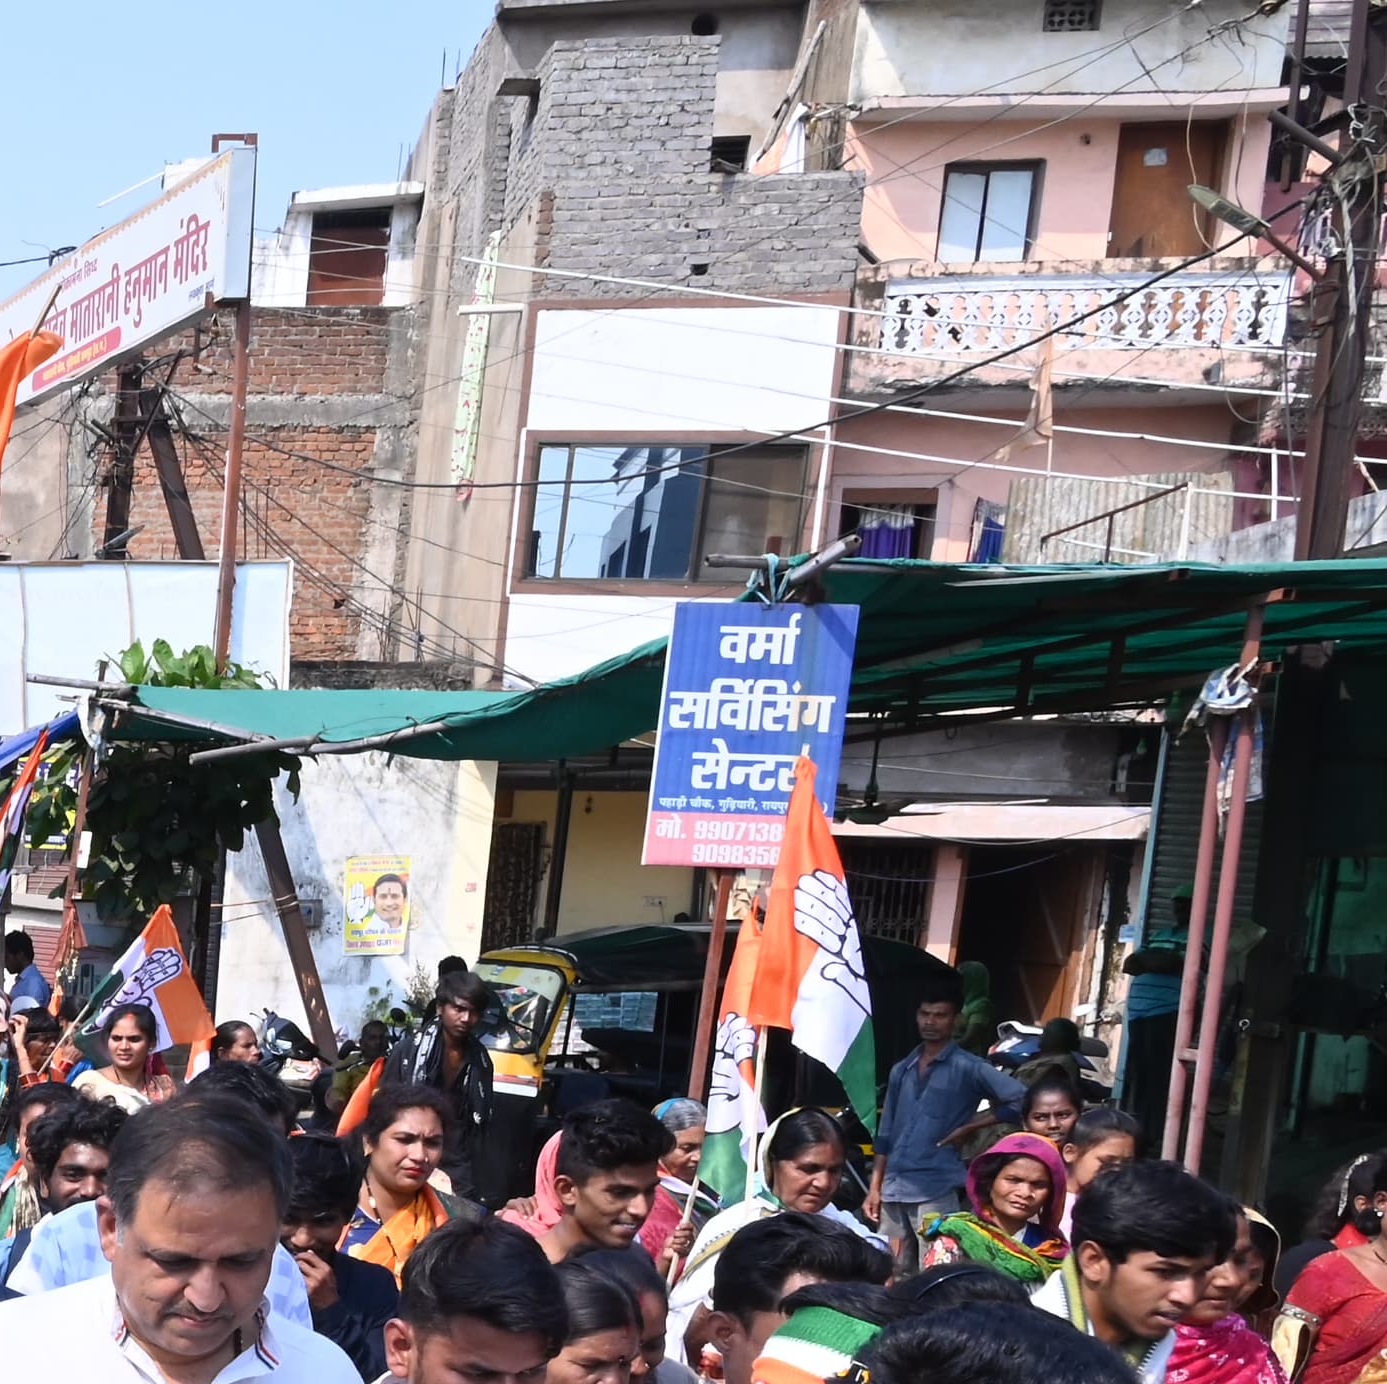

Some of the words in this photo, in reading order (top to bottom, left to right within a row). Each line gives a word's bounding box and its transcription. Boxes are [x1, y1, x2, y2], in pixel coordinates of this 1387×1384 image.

[70, 262, 120, 344] मातारानी
[124, 245, 170, 329] हनुमान
[174, 213, 210, 286] मंदिर
[720, 613, 802, 664] वर्मा
[668, 678, 836, 733] सर्विसिंग
